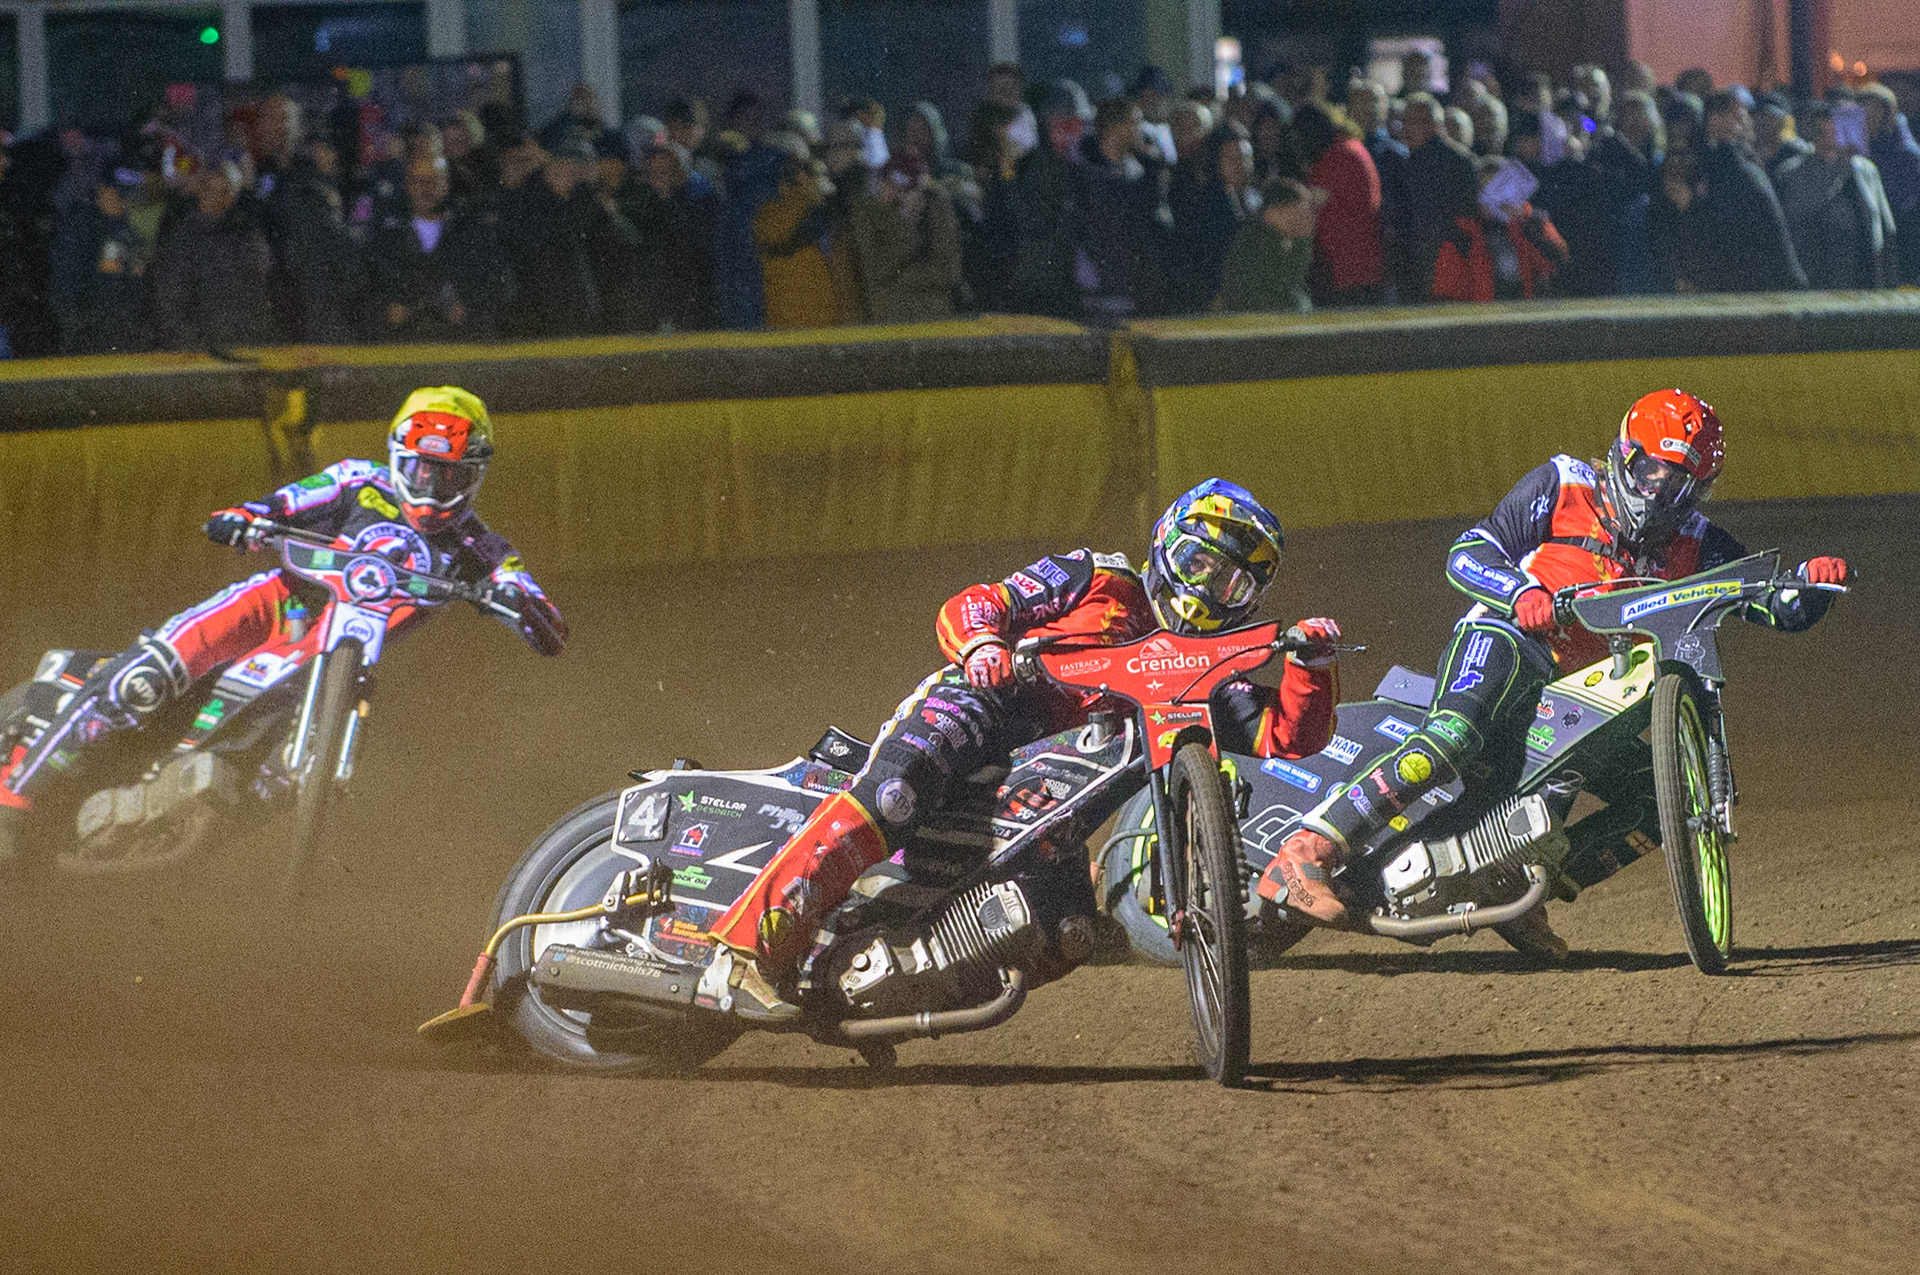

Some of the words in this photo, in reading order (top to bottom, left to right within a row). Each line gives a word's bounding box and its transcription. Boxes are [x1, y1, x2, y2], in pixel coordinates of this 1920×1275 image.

[1626, 596, 1667, 617] Allied
[1672, 584, 1737, 606] Vehicles
[1060, 658, 1101, 673] FASTRACK
[1126, 653, 1211, 674] Crendon
[695, 804, 743, 818] DESPATCH
[700, 795, 747, 812] STELLAR
[628, 794, 657, 837] 4
[564, 955, 662, 979] @scottnicholls78
